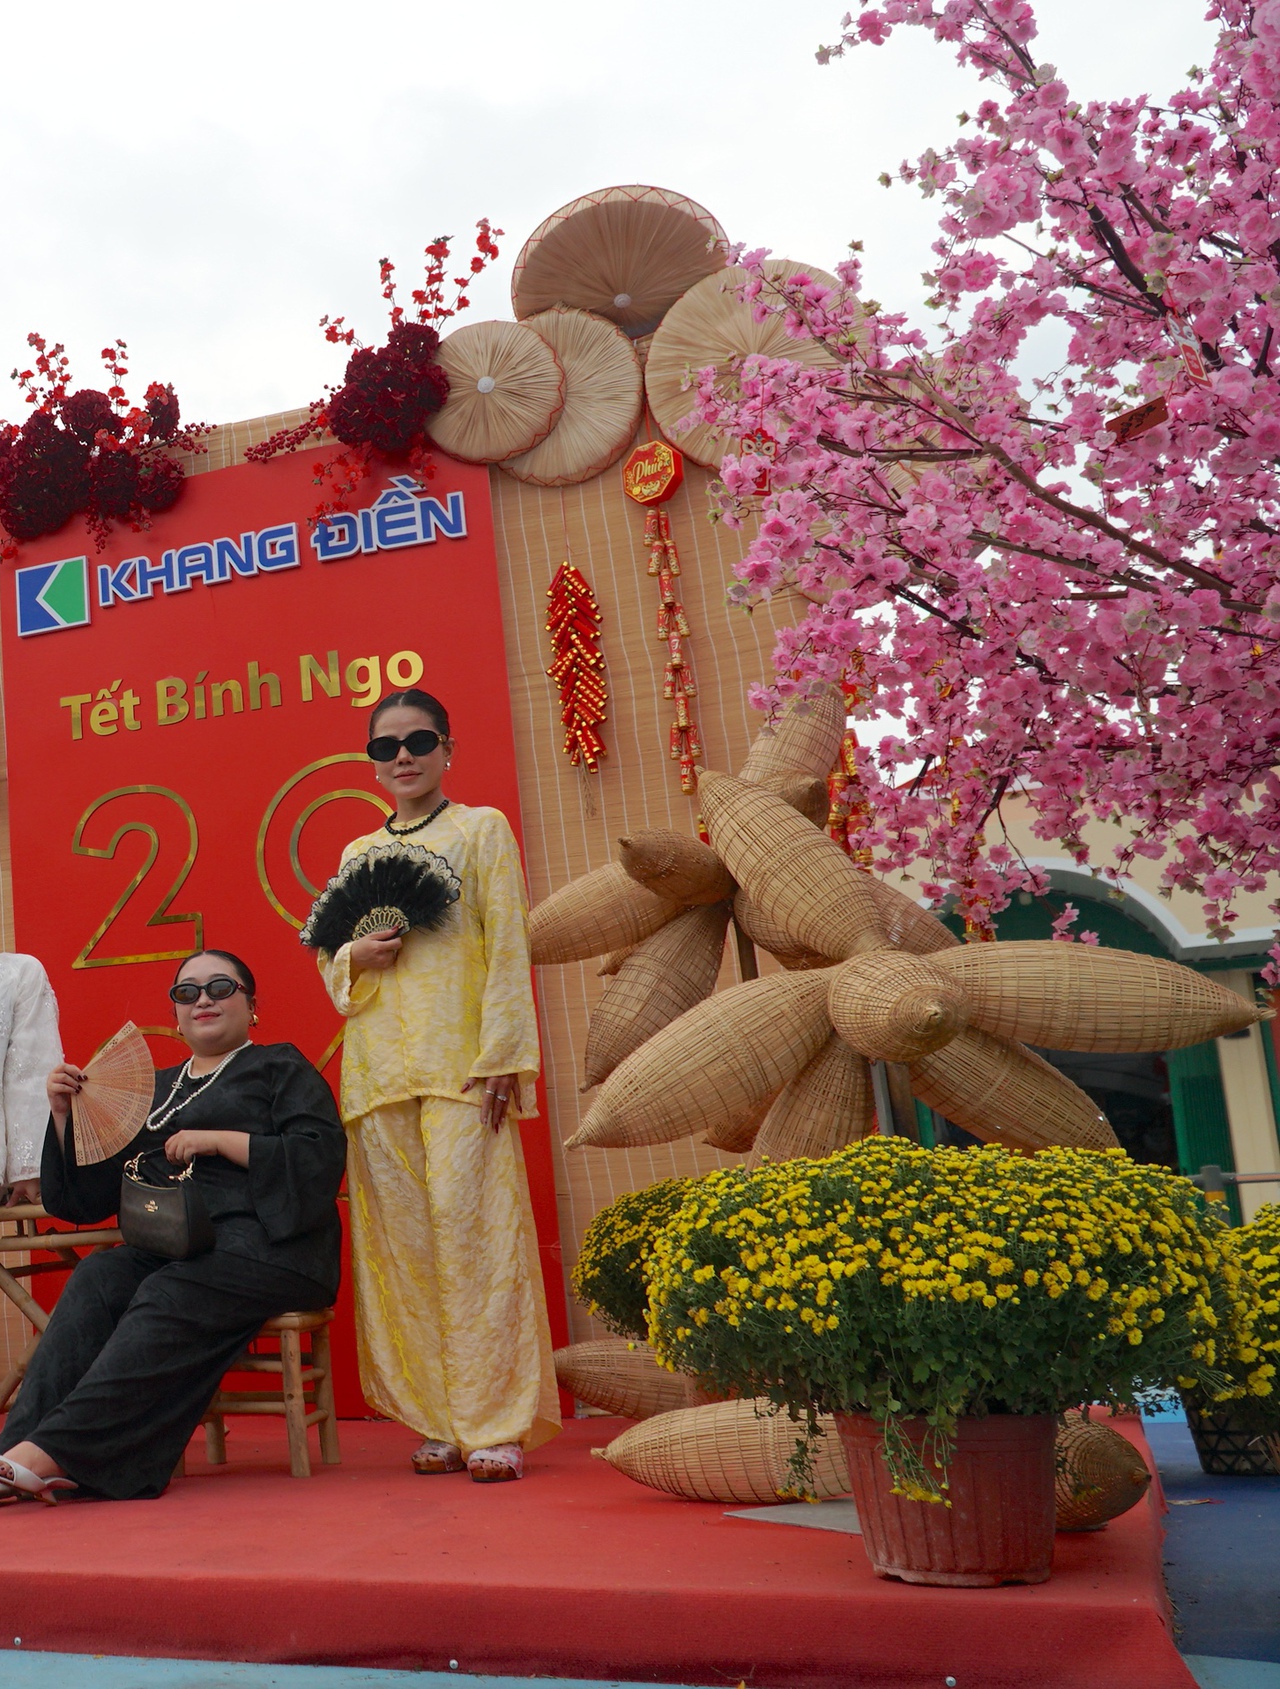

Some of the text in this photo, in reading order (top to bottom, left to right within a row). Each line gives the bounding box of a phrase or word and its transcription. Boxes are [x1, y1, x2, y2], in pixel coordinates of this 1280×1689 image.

[97, 475, 468, 608] KHANG ĐIỀN
[59, 679, 142, 741] Tết
[156, 661, 283, 727] Bính
